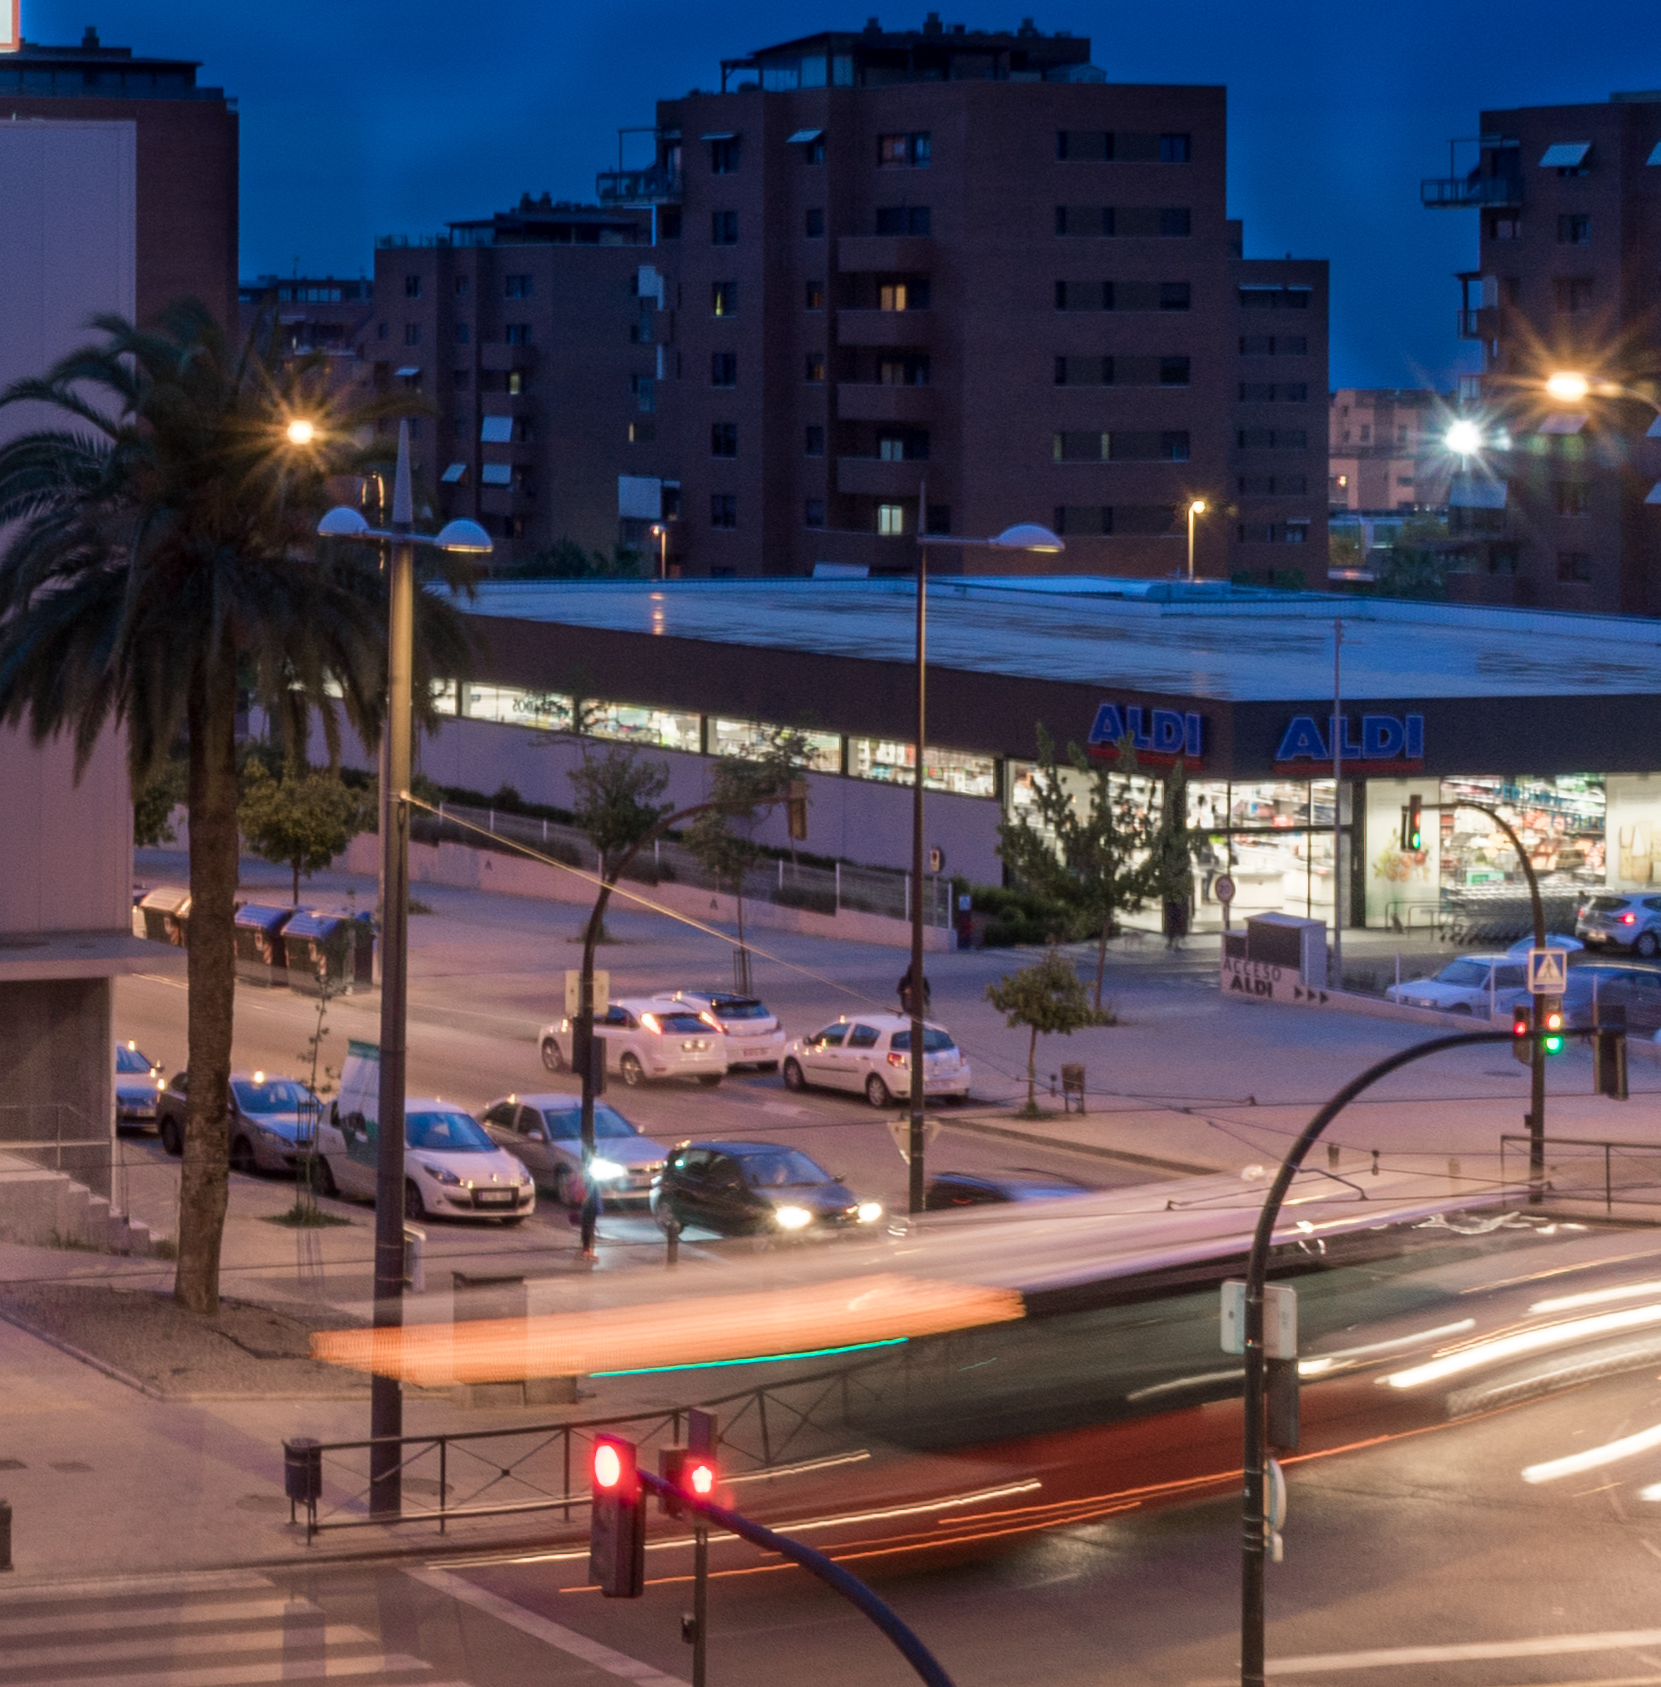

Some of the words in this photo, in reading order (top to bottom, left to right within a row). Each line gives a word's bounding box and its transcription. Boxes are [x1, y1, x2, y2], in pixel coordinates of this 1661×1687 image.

[1088, 703, 1202, 757] ALDI
[1275, 715, 1424, 761] ALDI
[1223, 957, 1282, 982] ACCESO
[1230, 975, 1273, 999] ALDI
